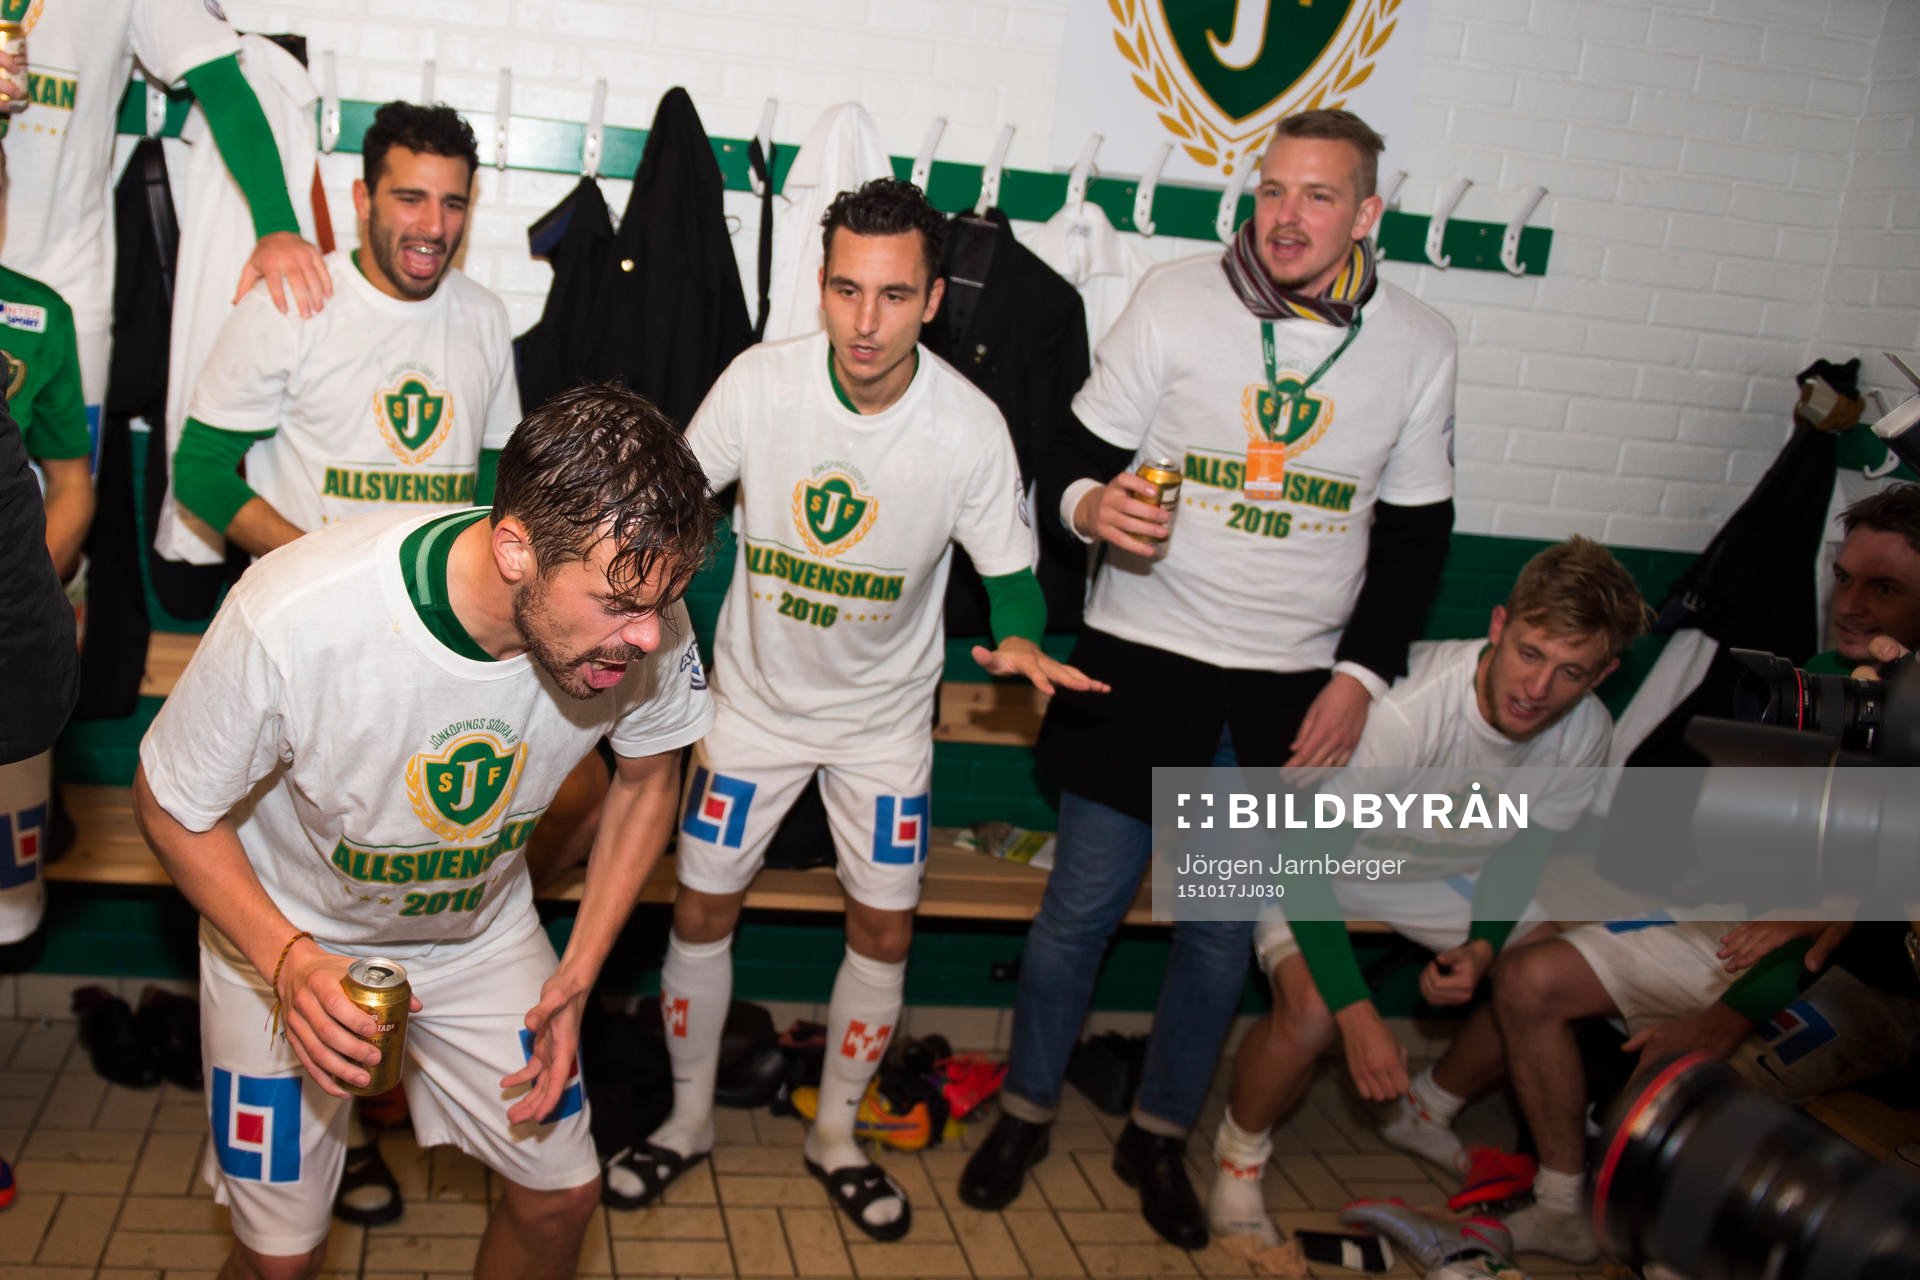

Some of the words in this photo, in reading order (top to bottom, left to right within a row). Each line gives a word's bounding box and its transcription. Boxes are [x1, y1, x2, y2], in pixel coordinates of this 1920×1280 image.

[1226, 503, 1293, 538] 2016
[777, 591, 839, 629] 2016
[399, 881, 487, 917] 2016
